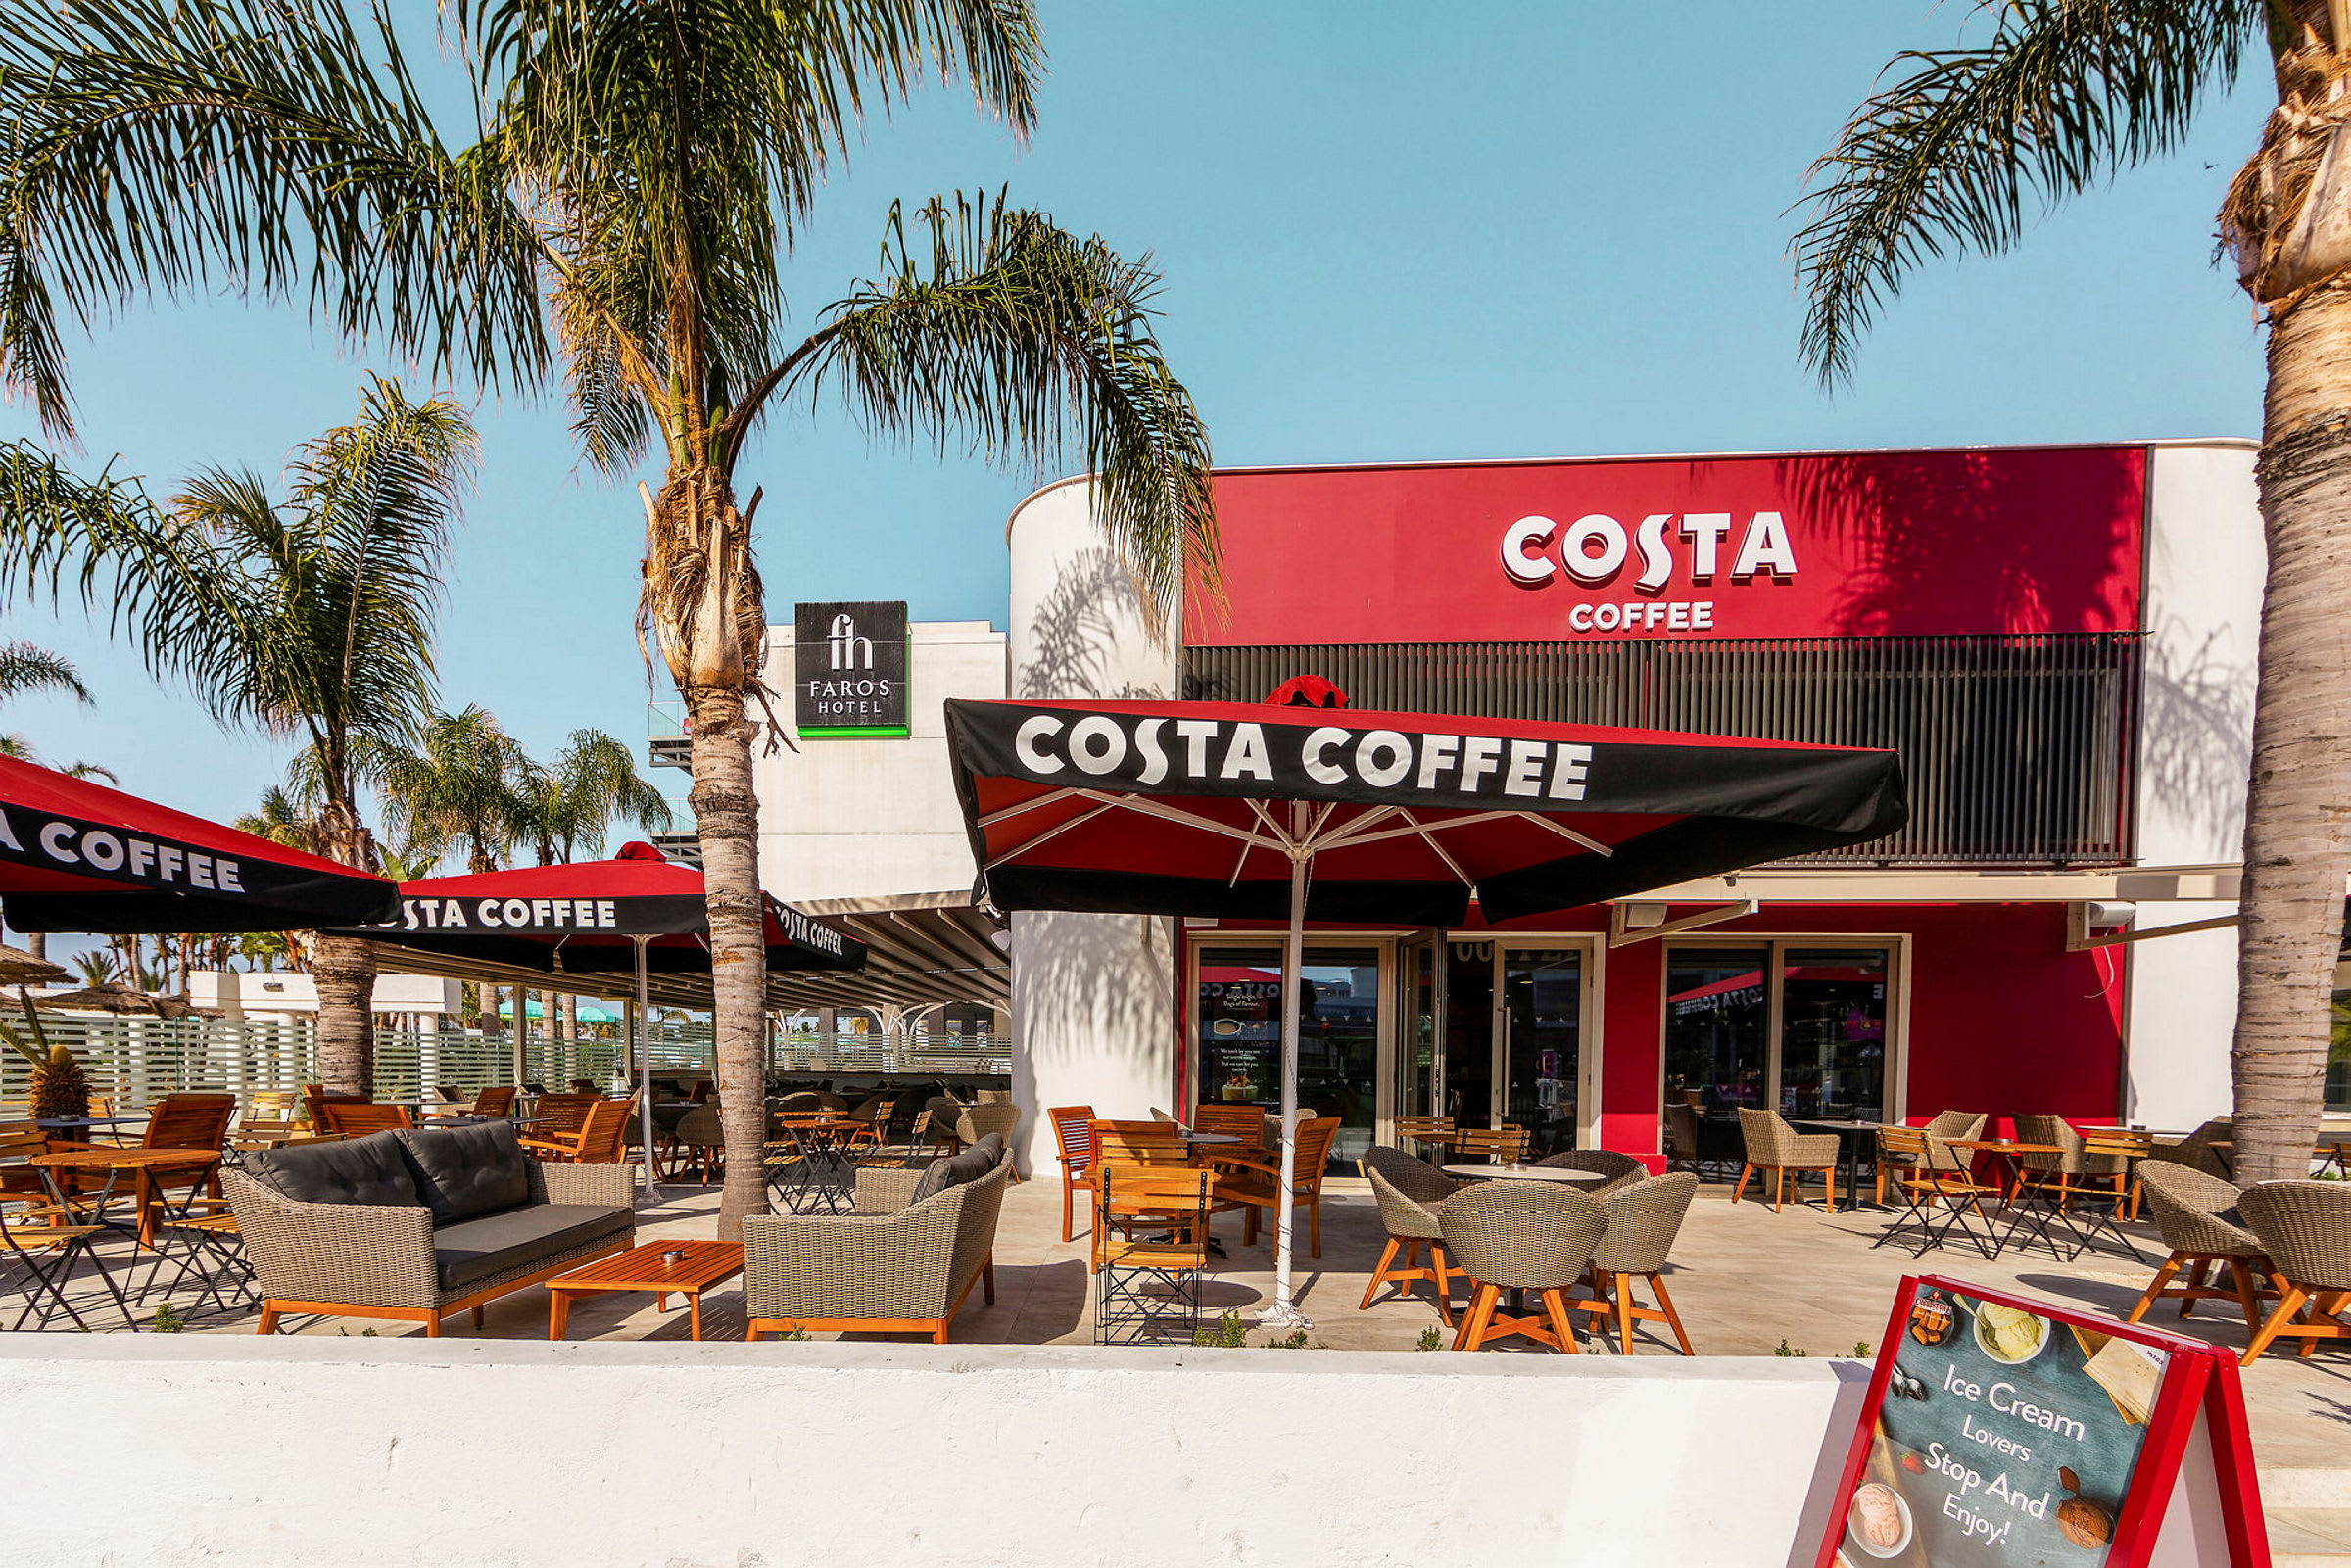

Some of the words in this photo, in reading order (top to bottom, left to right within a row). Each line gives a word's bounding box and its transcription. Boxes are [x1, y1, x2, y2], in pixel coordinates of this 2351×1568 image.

[1500, 511, 1798, 591] COSTA
[1569, 601, 1714, 632] COFFEE
[810, 679, 890, 697] FAROS
[818, 700, 882, 715] HOTEL
[1015, 714, 1273, 784] COSTA
[1302, 727, 1594, 801] COFFEE
[39, 821, 245, 893] COFFEE
[477, 898, 616, 928] COFFEE
[810, 922, 842, 956] COFFEE
[1943, 1363, 1981, 1401] Ice
[1989, 1382, 2085, 1442] Cream
[1962, 1414, 2032, 1462] Lovers
[1924, 1442, 1981, 1496] Stop
[1985, 1472, 2051, 1520] And
[1943, 1492, 2011, 1546] Enjoy!
